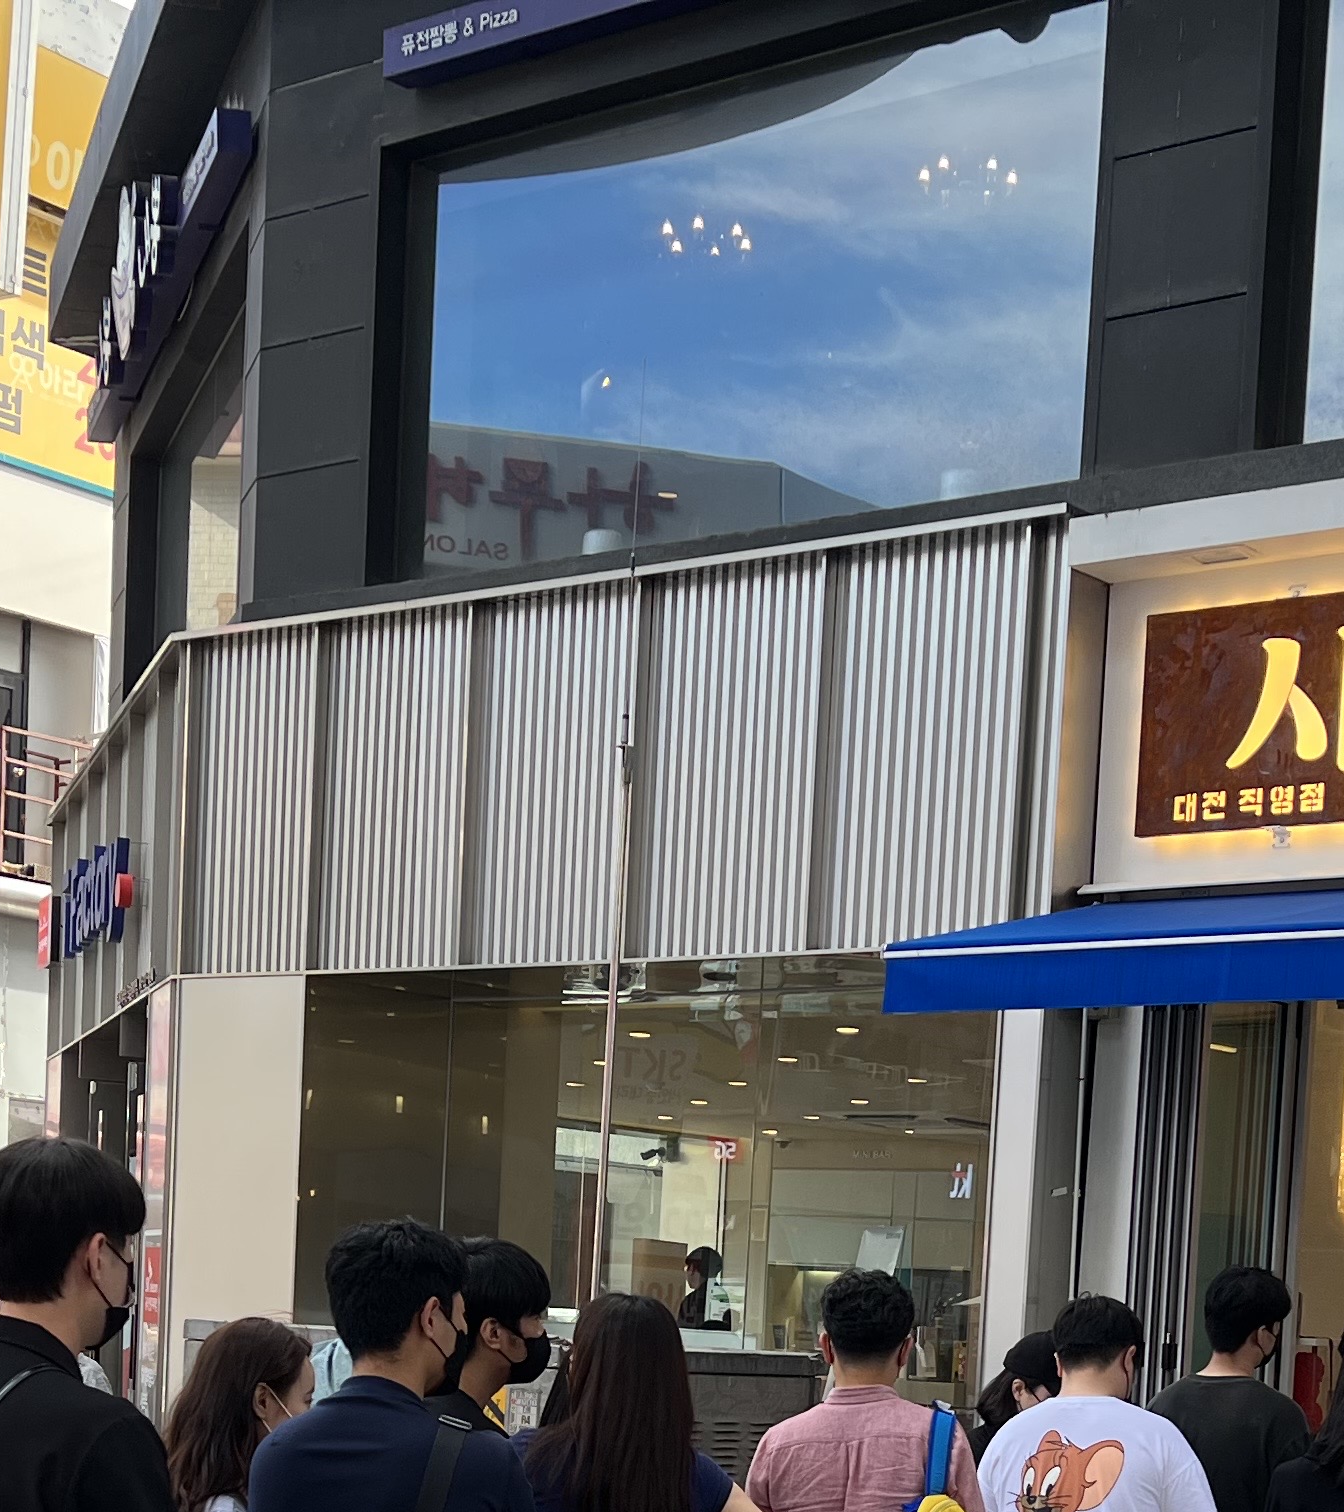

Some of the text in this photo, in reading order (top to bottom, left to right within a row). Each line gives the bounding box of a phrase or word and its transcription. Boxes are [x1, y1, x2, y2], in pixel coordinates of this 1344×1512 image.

[463, 17, 474, 36] &
[479, 6, 518, 33] Pizza
[1173, 782, 1325, 823] 대전 직영점
